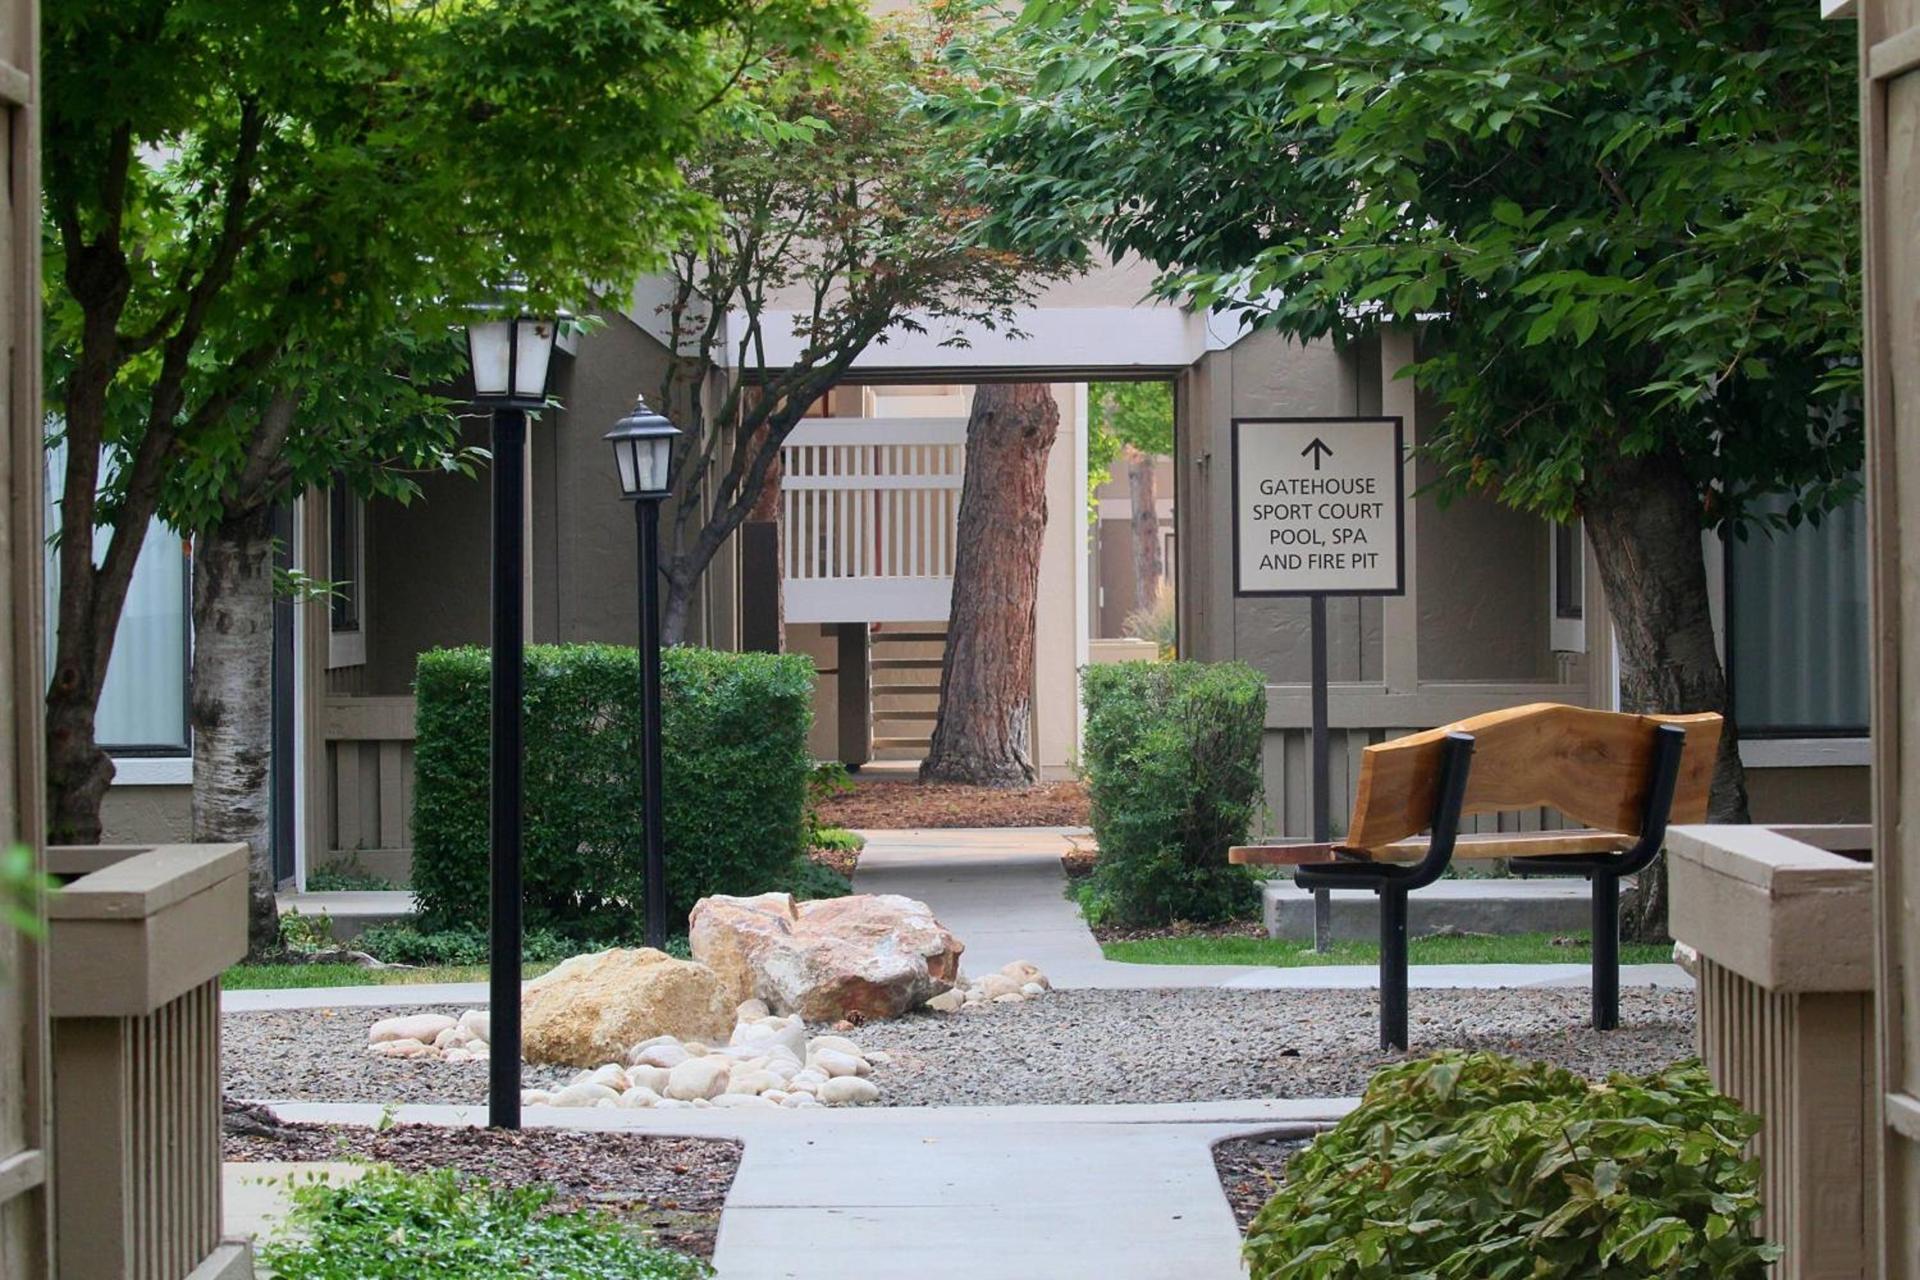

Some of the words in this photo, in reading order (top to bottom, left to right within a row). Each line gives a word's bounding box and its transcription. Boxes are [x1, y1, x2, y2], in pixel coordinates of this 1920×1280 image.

[1260, 478, 1376, 495] GATEHOUSE
[1253, 504, 1313, 520] SPORT
[1318, 503, 1383, 519] COURT
[1270, 529, 1326, 547] POOL,
[1332, 528, 1367, 544] SPA
[1259, 554, 1302, 570] AND
[1308, 553, 1345, 569] FIRE
[1352, 553, 1379, 569] PIT
